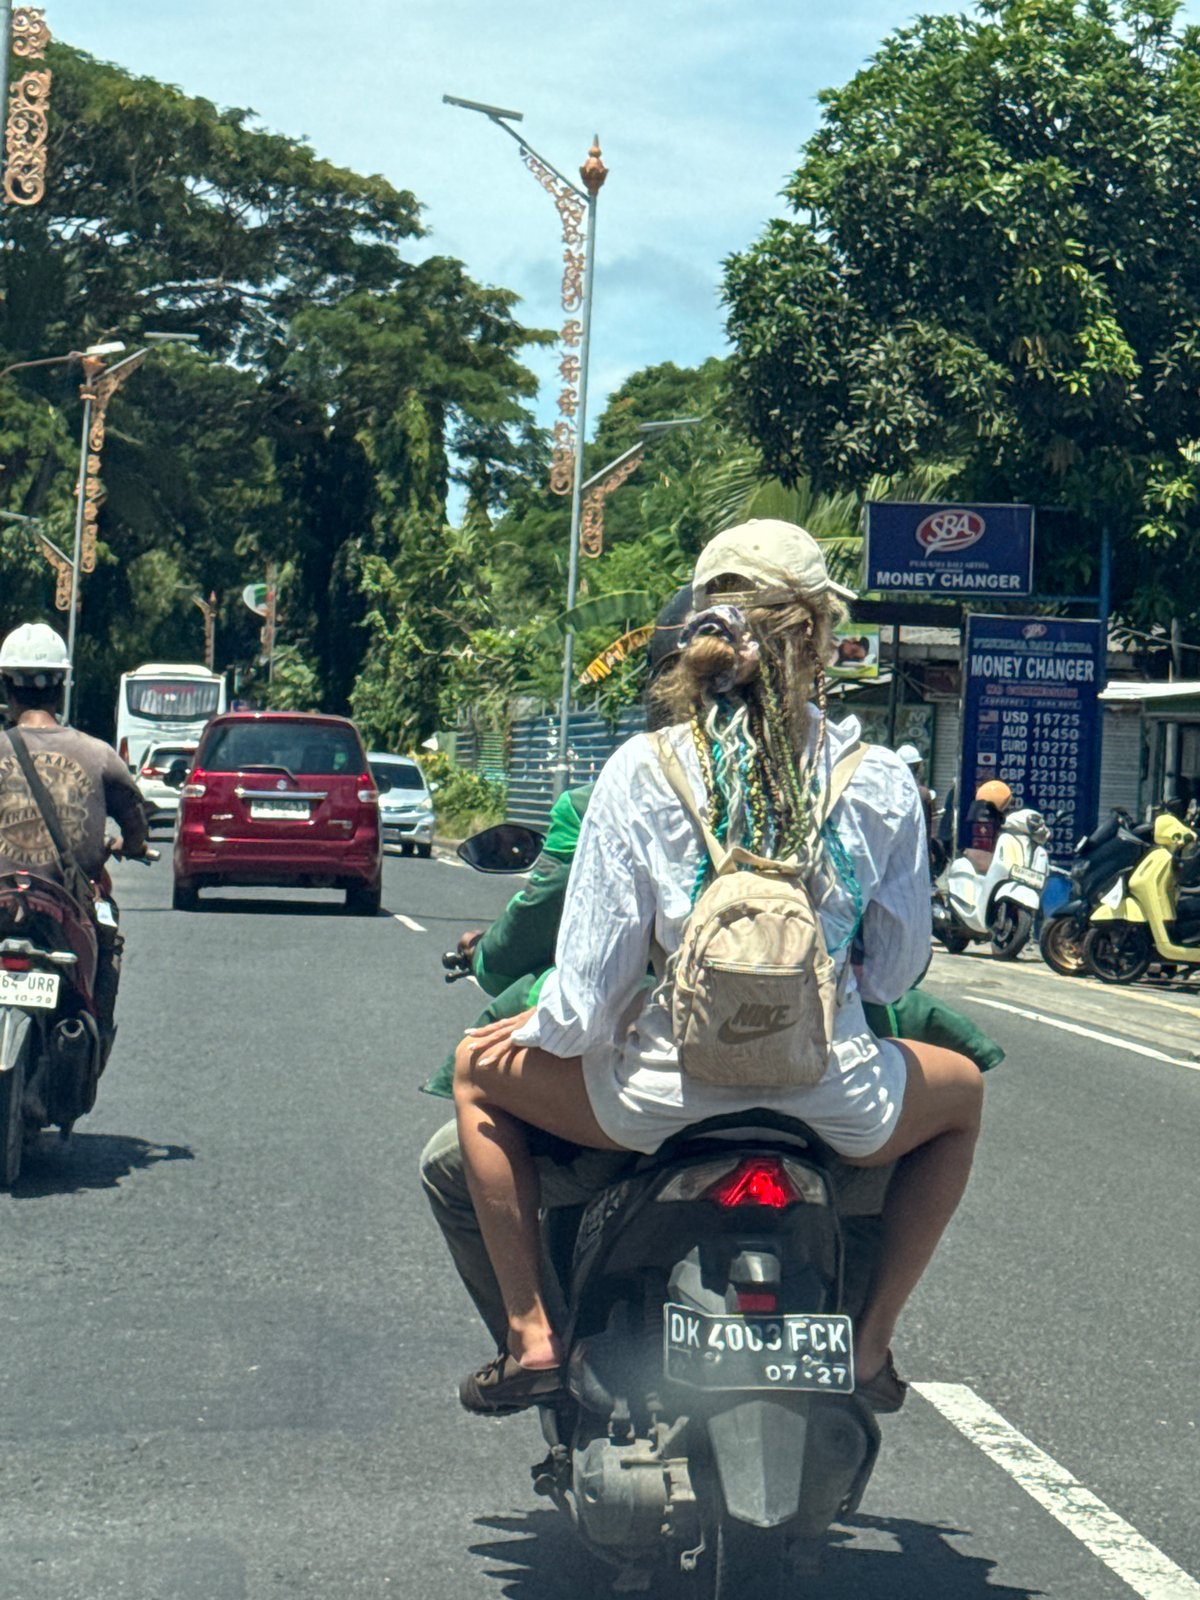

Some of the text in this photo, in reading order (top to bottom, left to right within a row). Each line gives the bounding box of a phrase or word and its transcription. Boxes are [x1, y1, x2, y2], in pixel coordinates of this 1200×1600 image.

[927, 514, 975, 542] SBA
[877, 571, 1021, 589] MONEY CHANGER
[971, 654, 1095, 681] MONEY CHANGER
[1002, 711, 1080, 726] USD 16725
[1002, 725, 1079, 740] AUD 11450
[1001, 739, 1079, 755] EURO 19275
[1000, 754, 1078, 769] JPN 10375
[999, 768, 1077, 783] GBP 22150
[1029, 784, 1076, 797] 12925
[1039, 798, 1076, 812] 9400
[28, 976, 55, 992] URR
[731, 1002, 790, 1026] NIKE
[671, 1313, 701, 1348] DK
[789, 1322, 847, 1352] FCK
